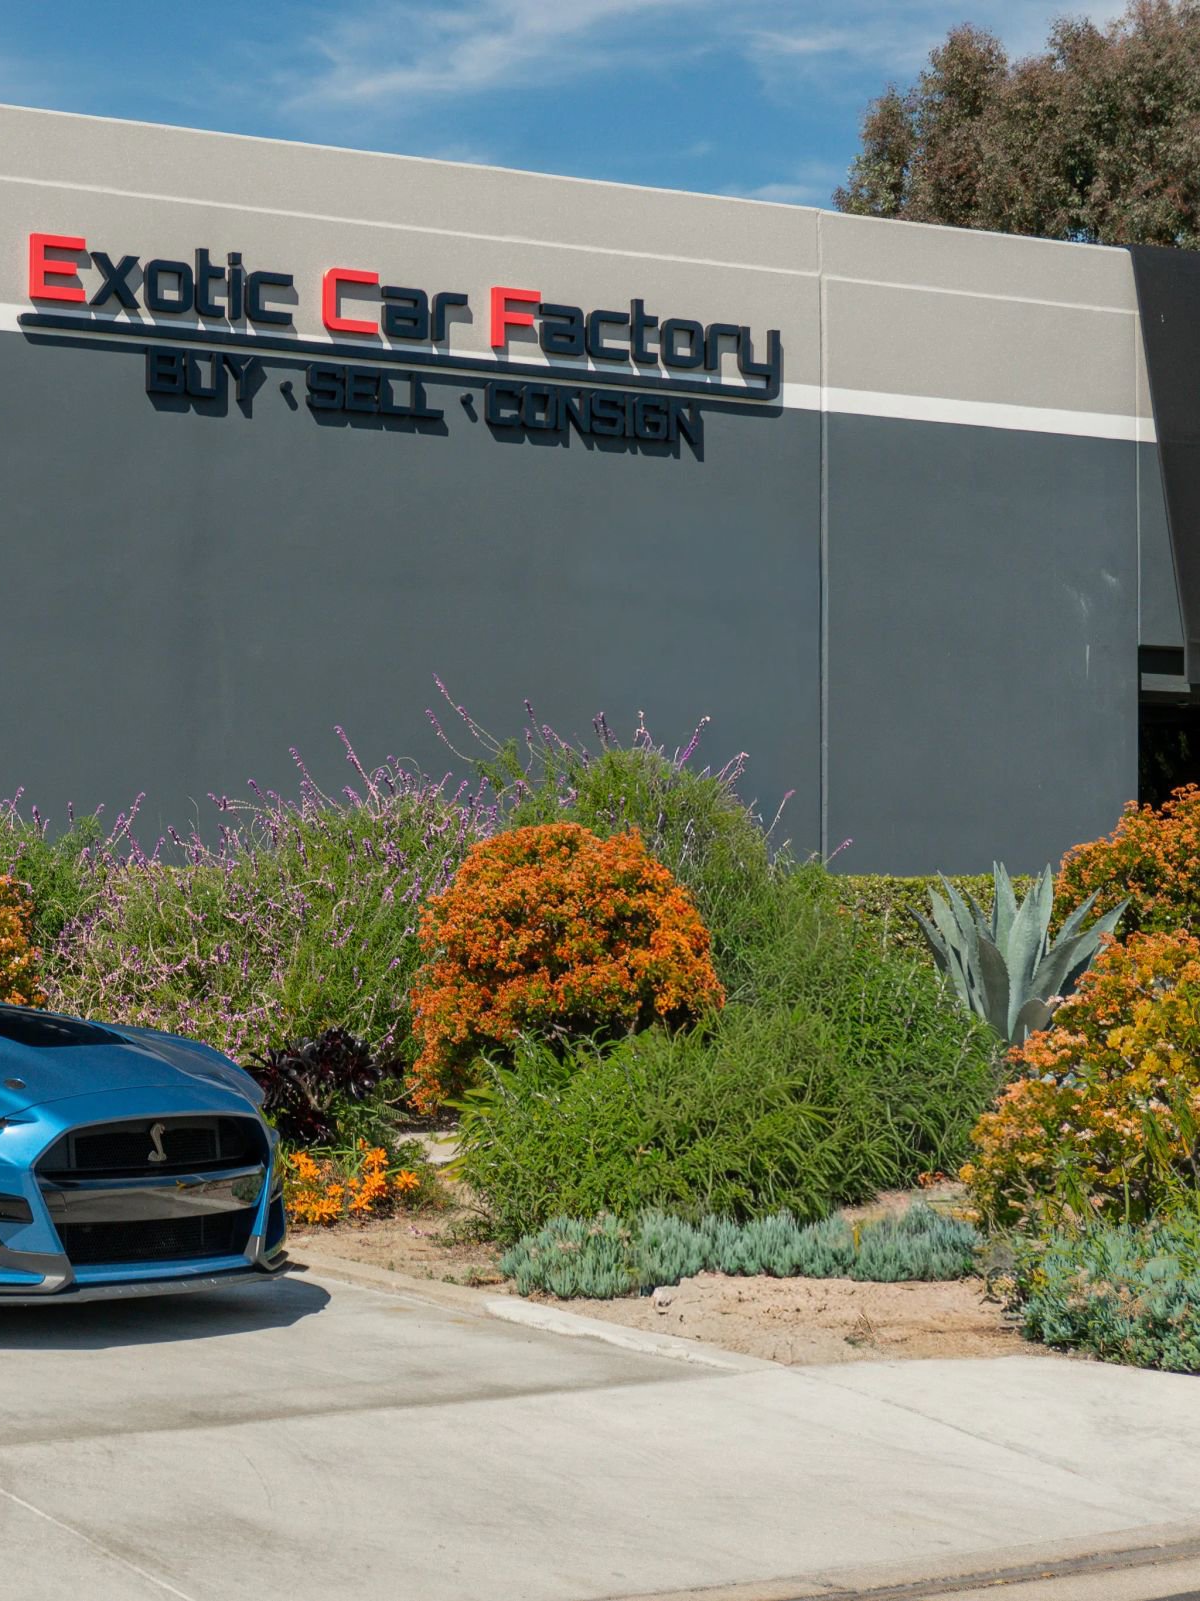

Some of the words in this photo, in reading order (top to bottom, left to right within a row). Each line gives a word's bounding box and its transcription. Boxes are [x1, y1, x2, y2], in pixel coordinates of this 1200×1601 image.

[29, 233, 293, 325] Exotic
[322, 267, 468, 342] Car
[490, 286, 781, 400] Factory
[146, 346, 255, 402] BUY
[305, 363, 445, 419] SELL
[484, 381, 702, 445] CONSIGN
